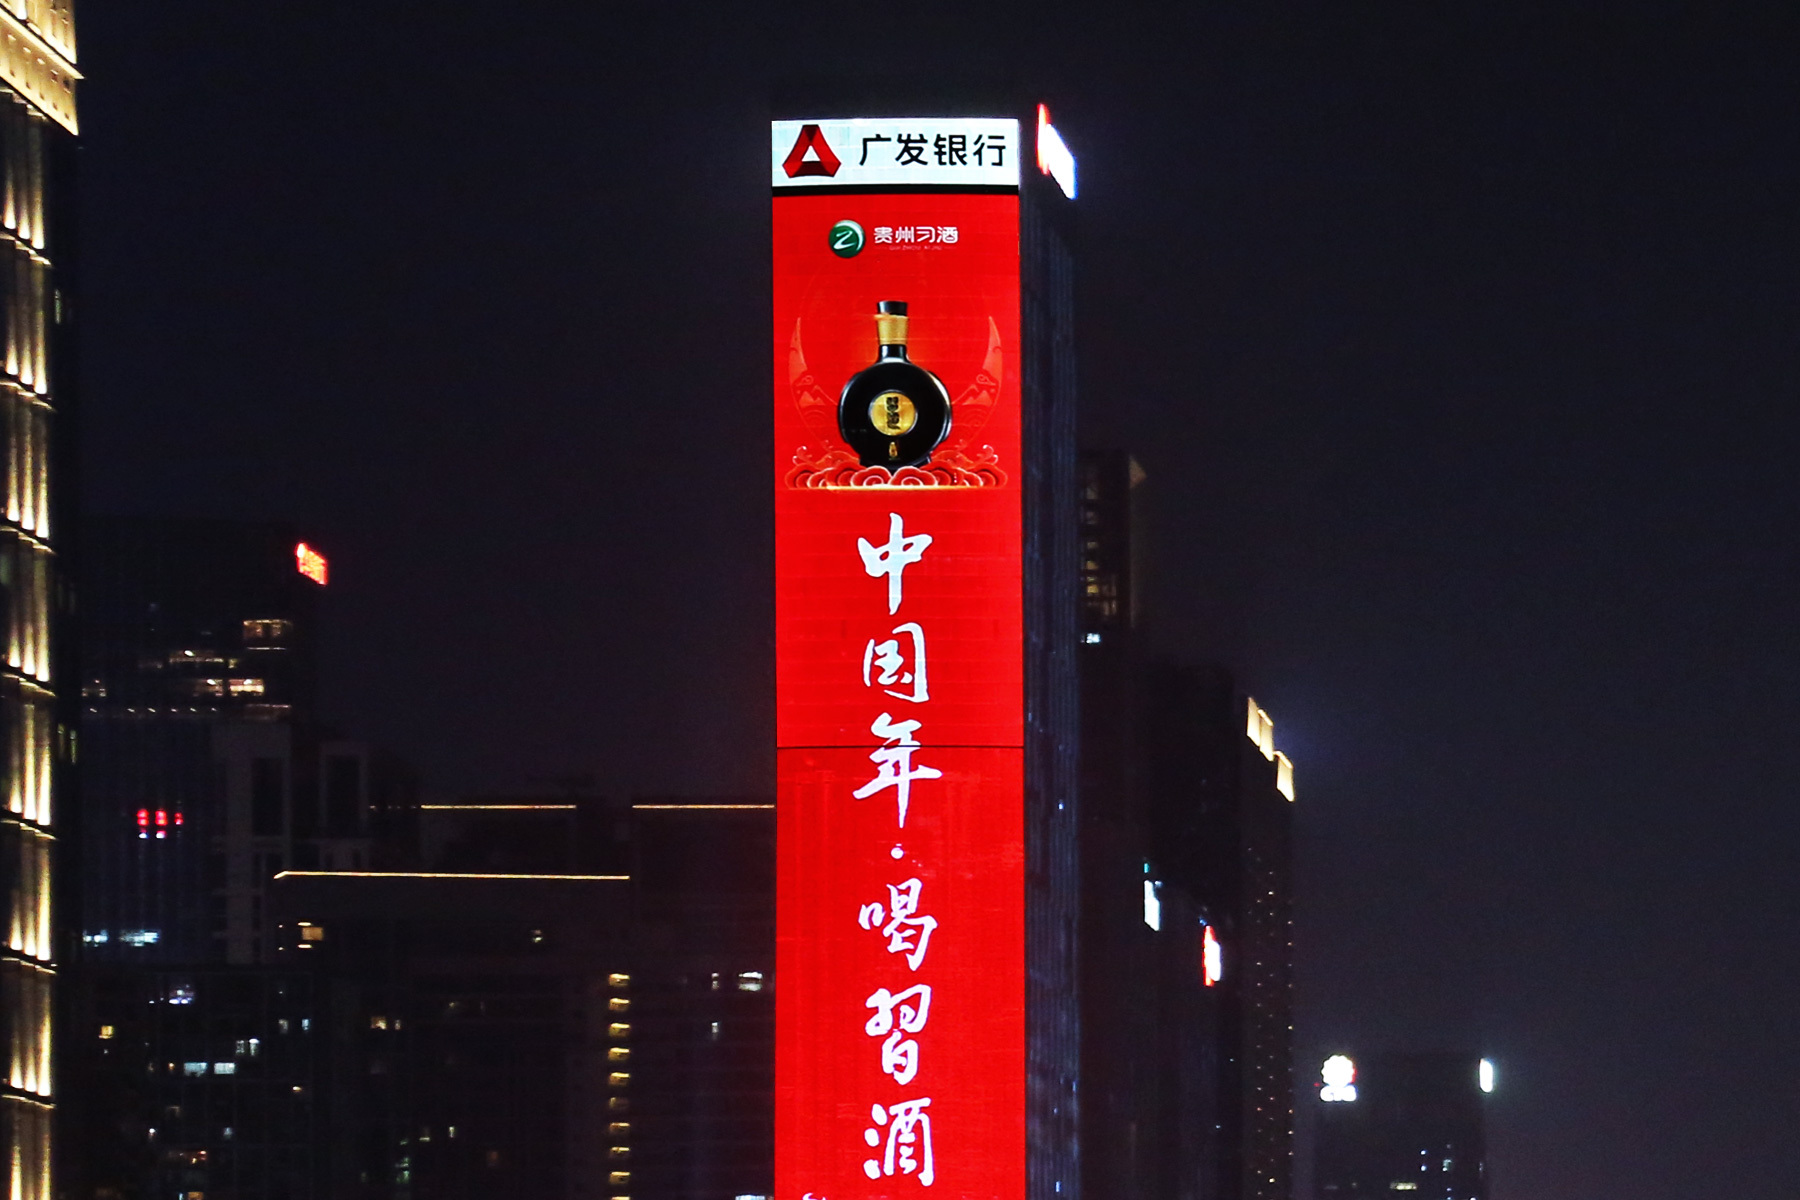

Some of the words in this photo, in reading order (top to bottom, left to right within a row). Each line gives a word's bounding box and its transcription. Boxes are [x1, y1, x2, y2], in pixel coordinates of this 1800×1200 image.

[860, 133, 1006, 167] 广发银行
[873, 225, 959, 244] 贵州习酒
